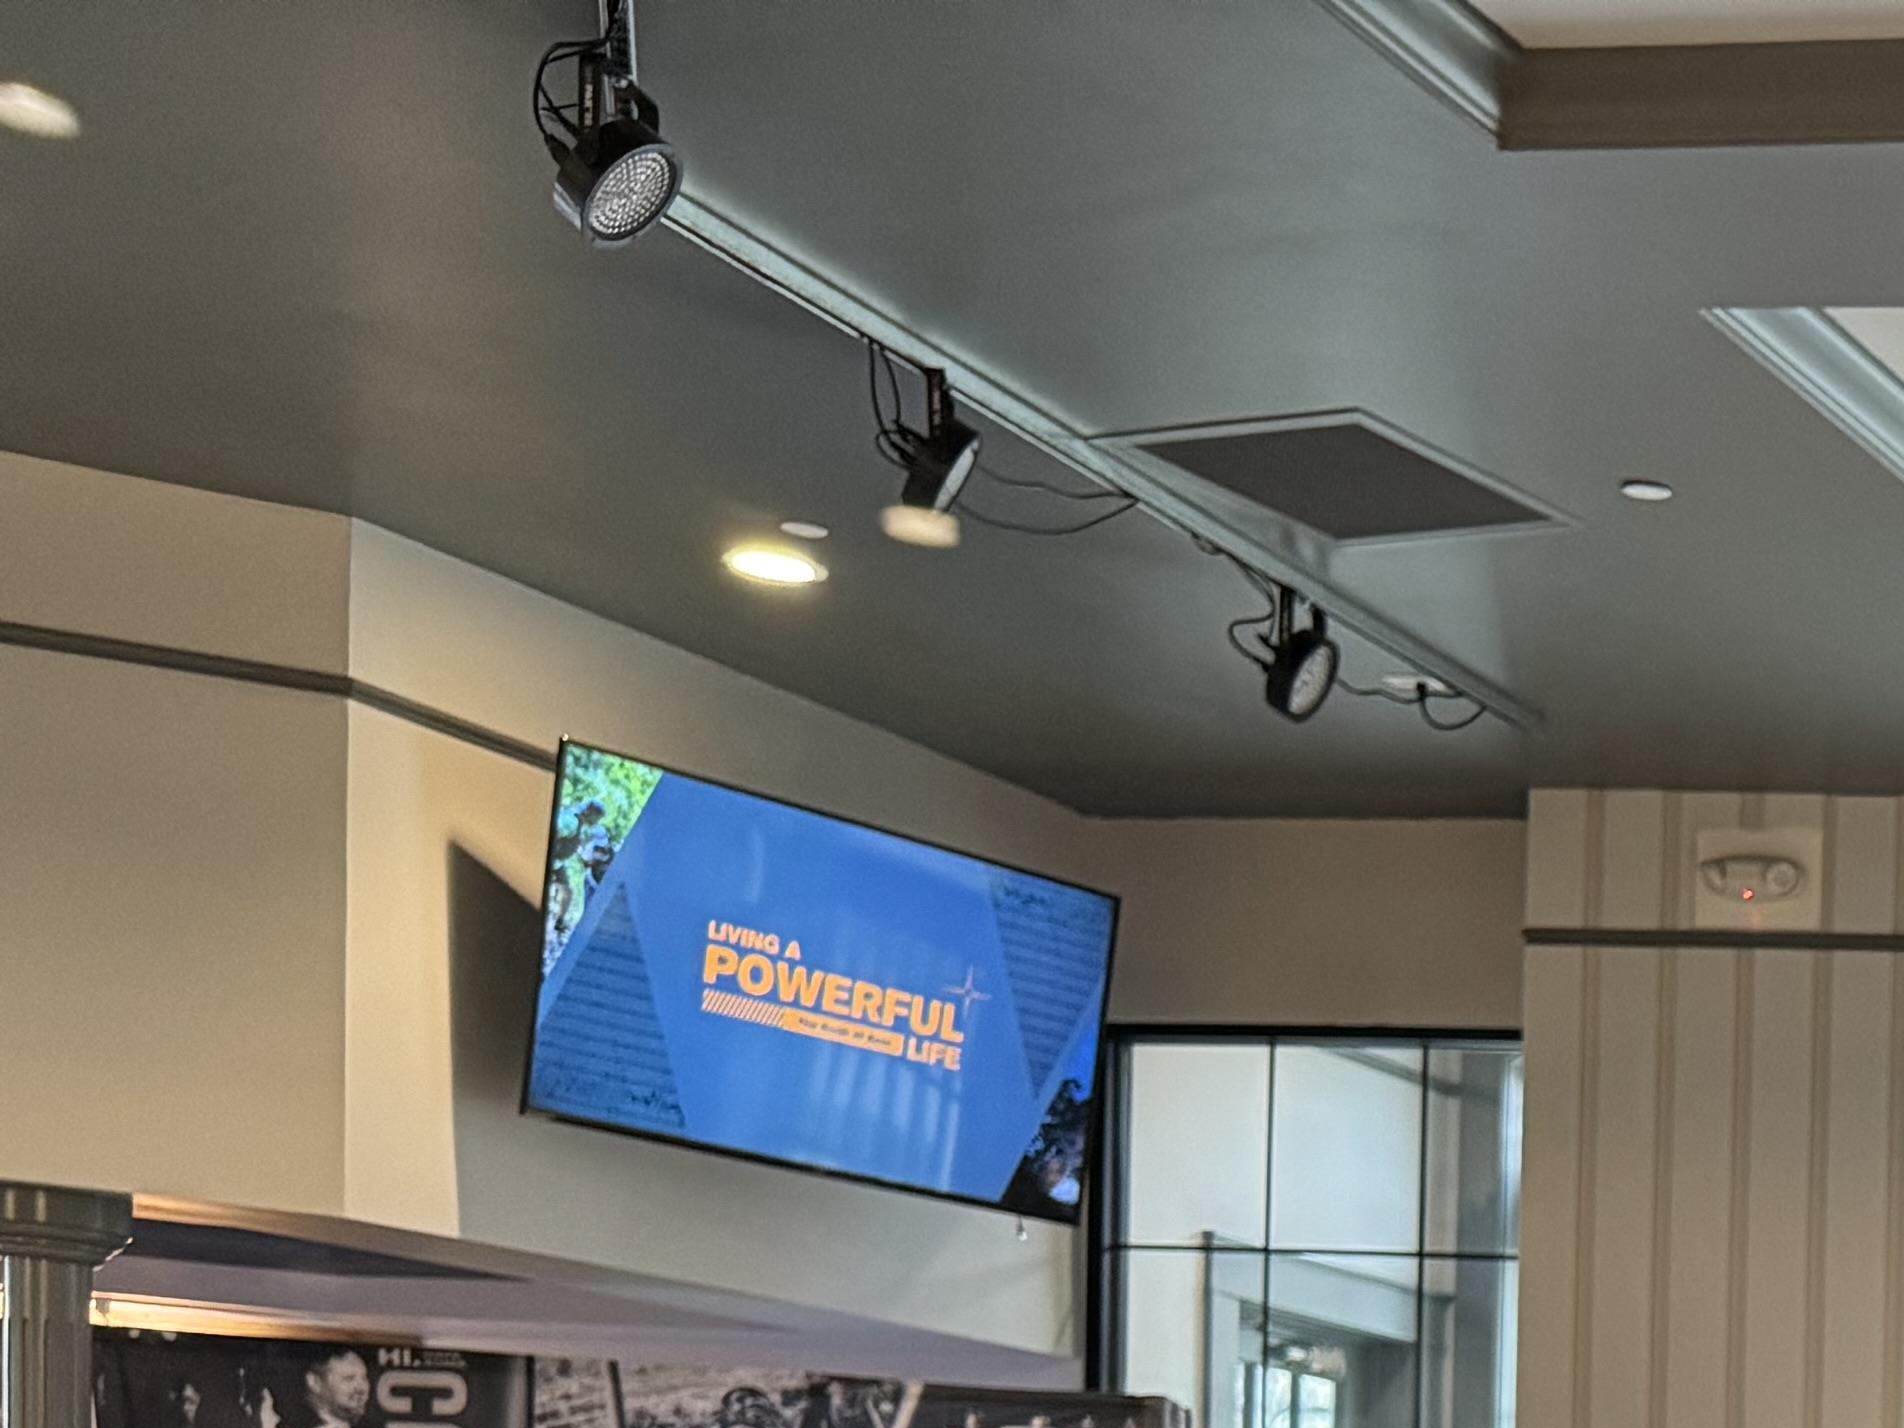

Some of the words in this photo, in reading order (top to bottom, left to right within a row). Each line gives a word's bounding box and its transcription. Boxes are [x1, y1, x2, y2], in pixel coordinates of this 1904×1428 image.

[707, 919, 780, 955] LIVING
[784, 940, 802, 961] A
[703, 943, 965, 1044] POWERFUL
[906, 1036, 963, 1072] LIFE
